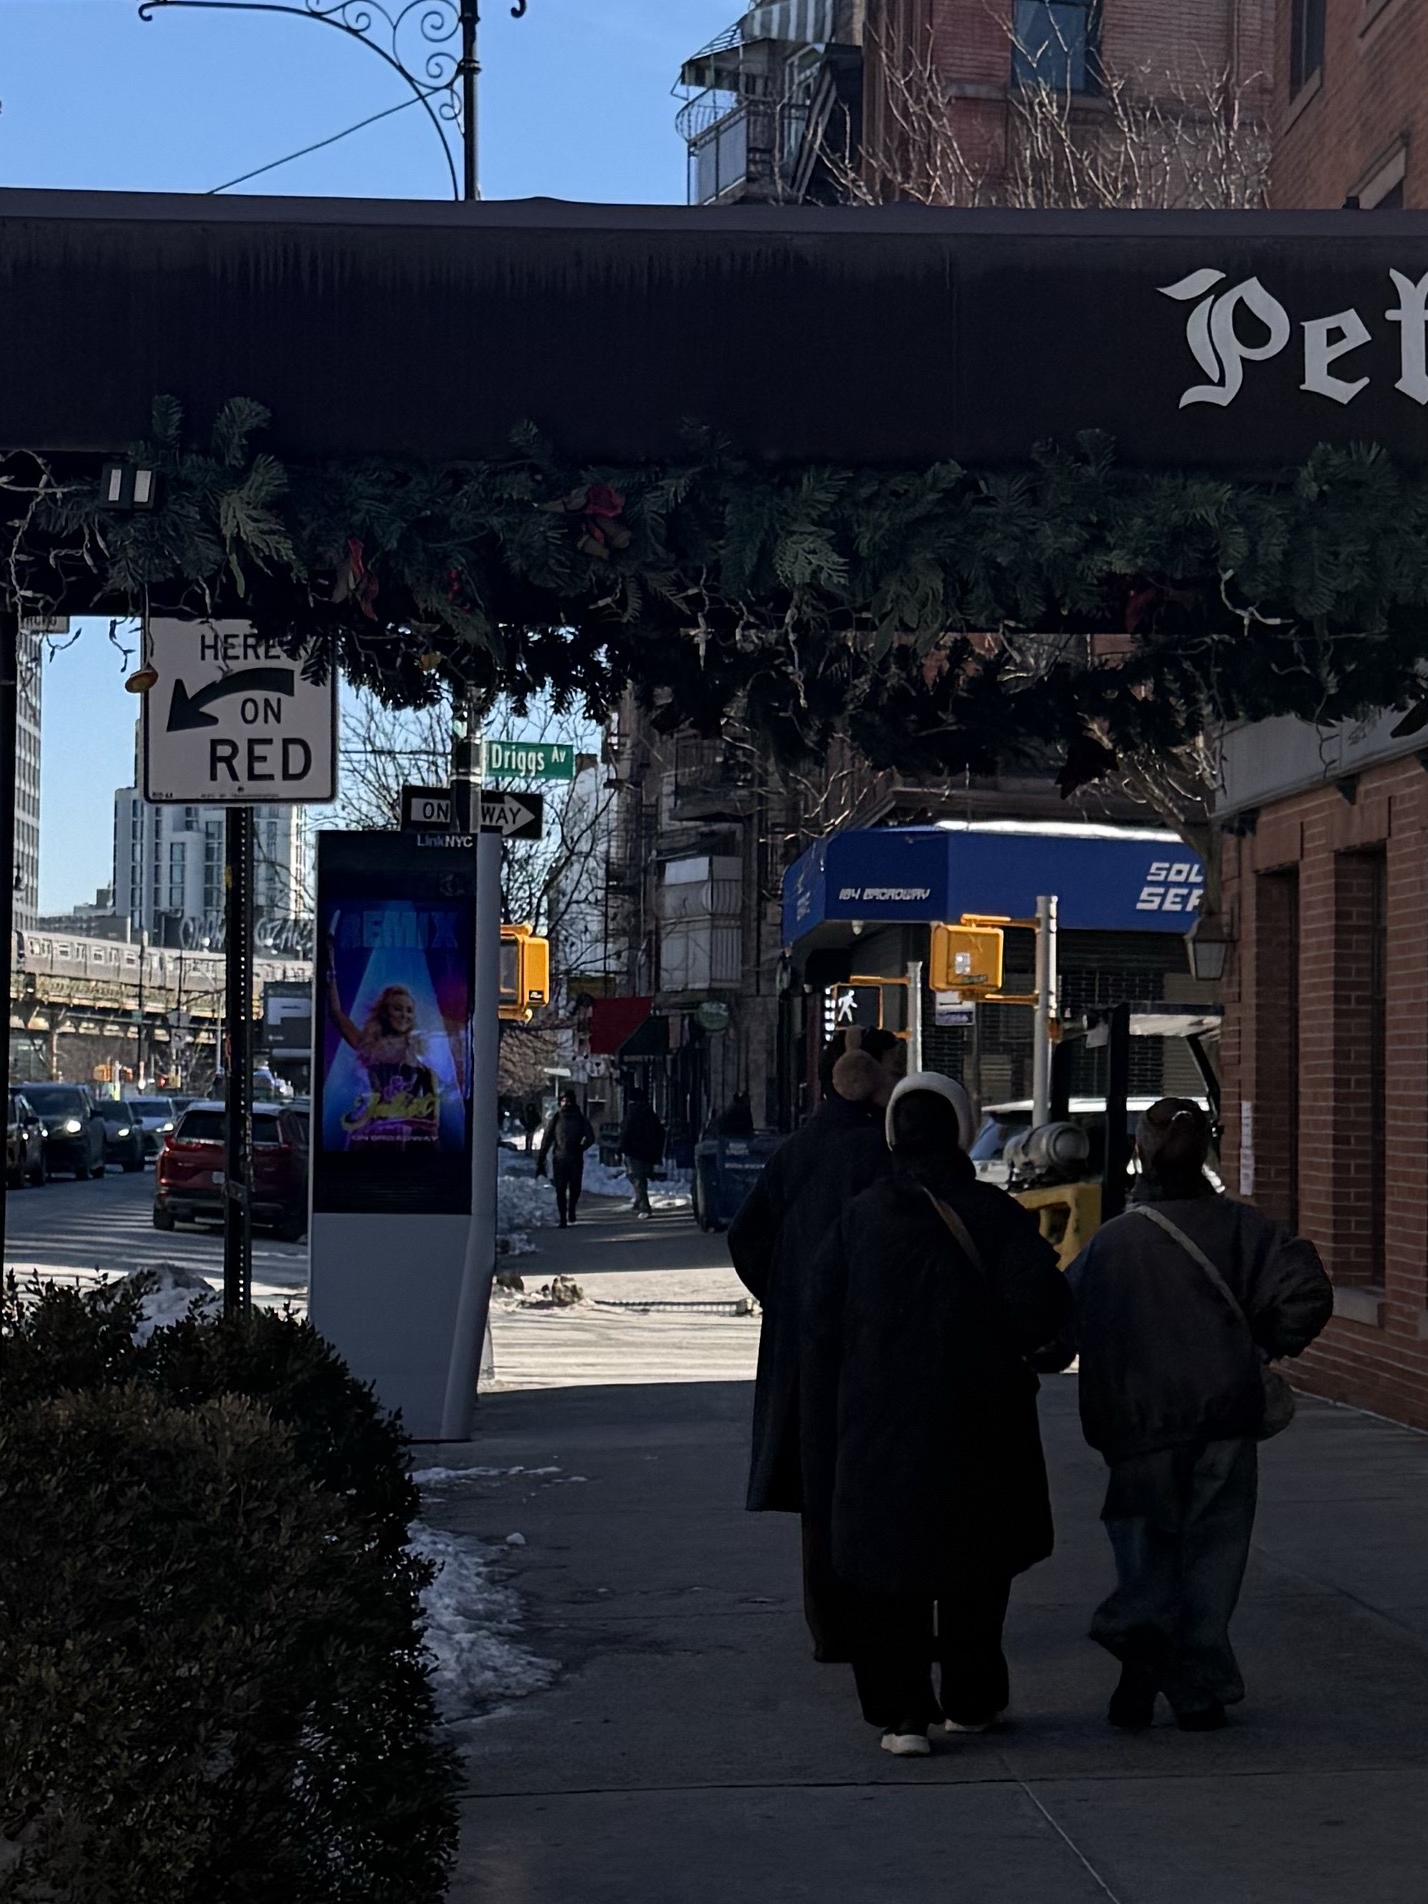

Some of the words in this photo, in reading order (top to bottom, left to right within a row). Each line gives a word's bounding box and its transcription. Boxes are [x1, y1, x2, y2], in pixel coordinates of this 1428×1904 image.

[241, 697, 281, 724] ON
[210, 738, 312, 782] RED
[491, 743, 546, 778] Driggs
[551, 746, 567, 764] Av
[422, 801, 450, 821] ON
[481, 806, 522, 825] WAY
[417, 834, 474, 848] LinkNYC
[863, 888, 931, 901] BROADWAY
